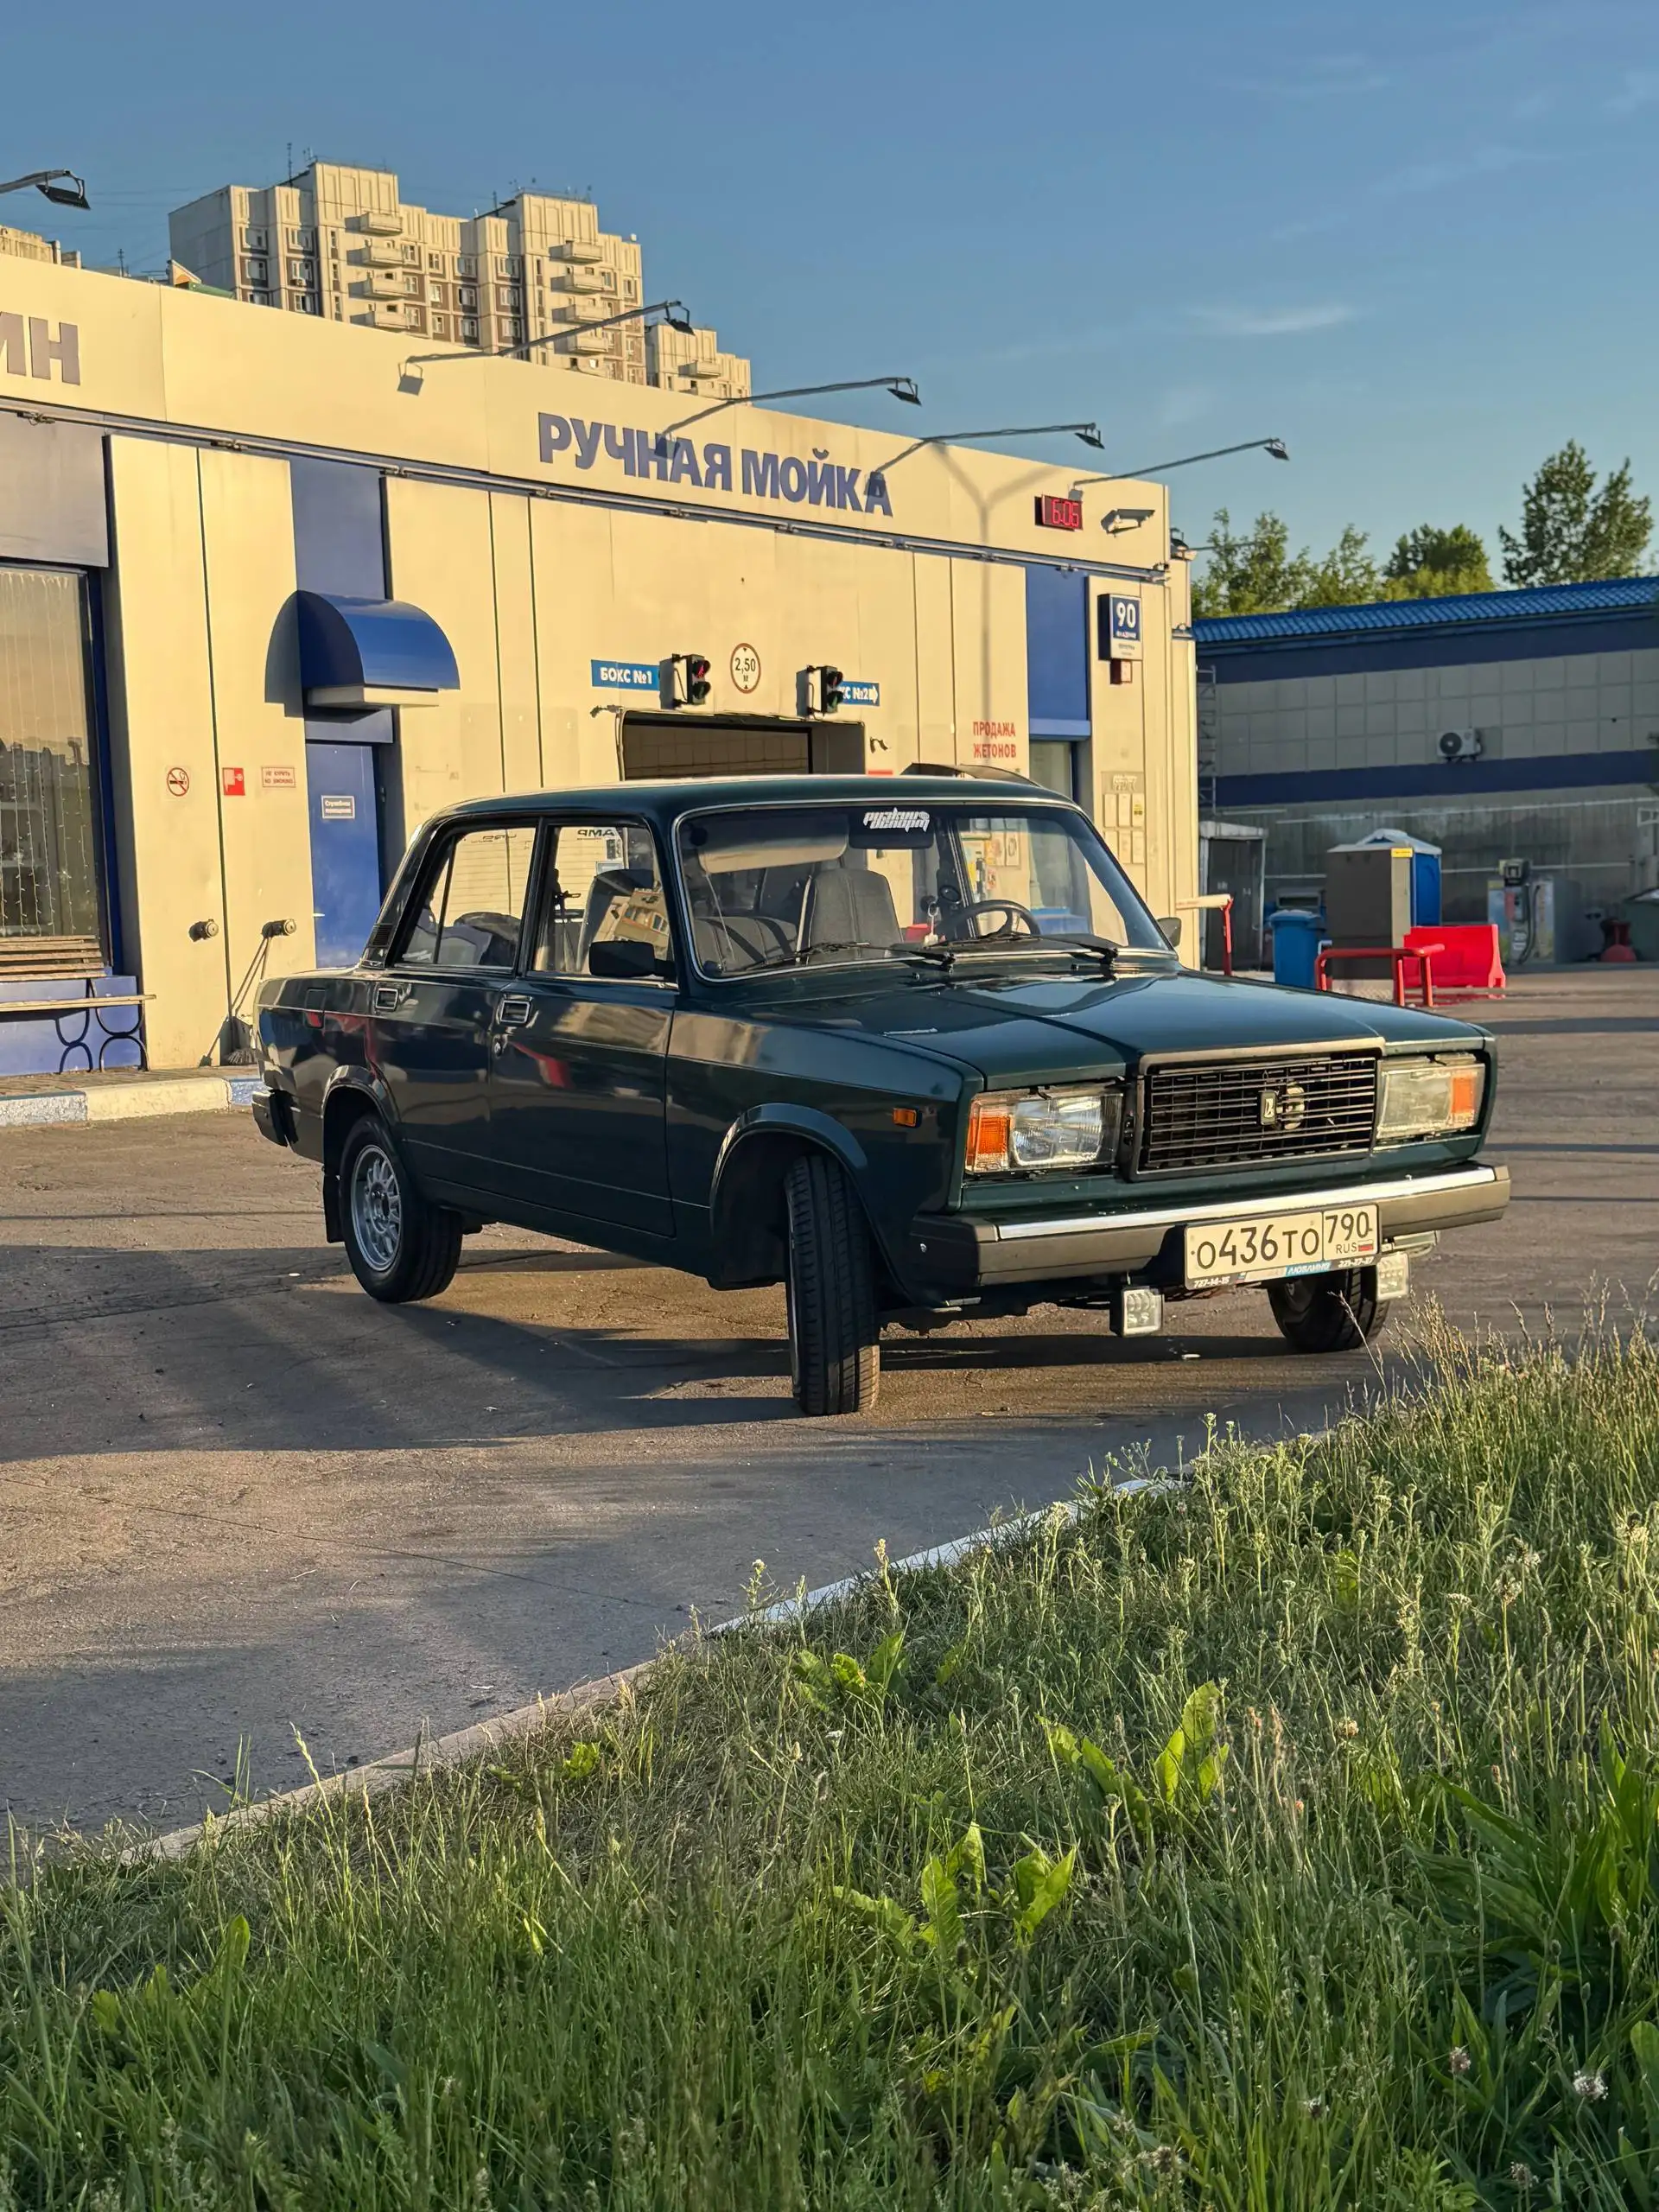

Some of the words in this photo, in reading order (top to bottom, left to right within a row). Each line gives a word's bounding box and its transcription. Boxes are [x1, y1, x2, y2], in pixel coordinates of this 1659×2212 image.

[537, 411, 733, 492] РУЧНАЯ
[741, 448, 893, 518] МОЙКА
[1116, 601, 1136, 628] 90
[734, 657, 756, 674] 2,50
[600, 666, 632, 683] БОКС
[632, 670, 652, 684] №1
[973, 721, 1016, 738] ПРОДАЖА
[973, 743, 1017, 758] ЖЕТОНОВ
[1325, 1211, 1370, 1243] 790
[1336, 1242, 1357, 1254] RUS
